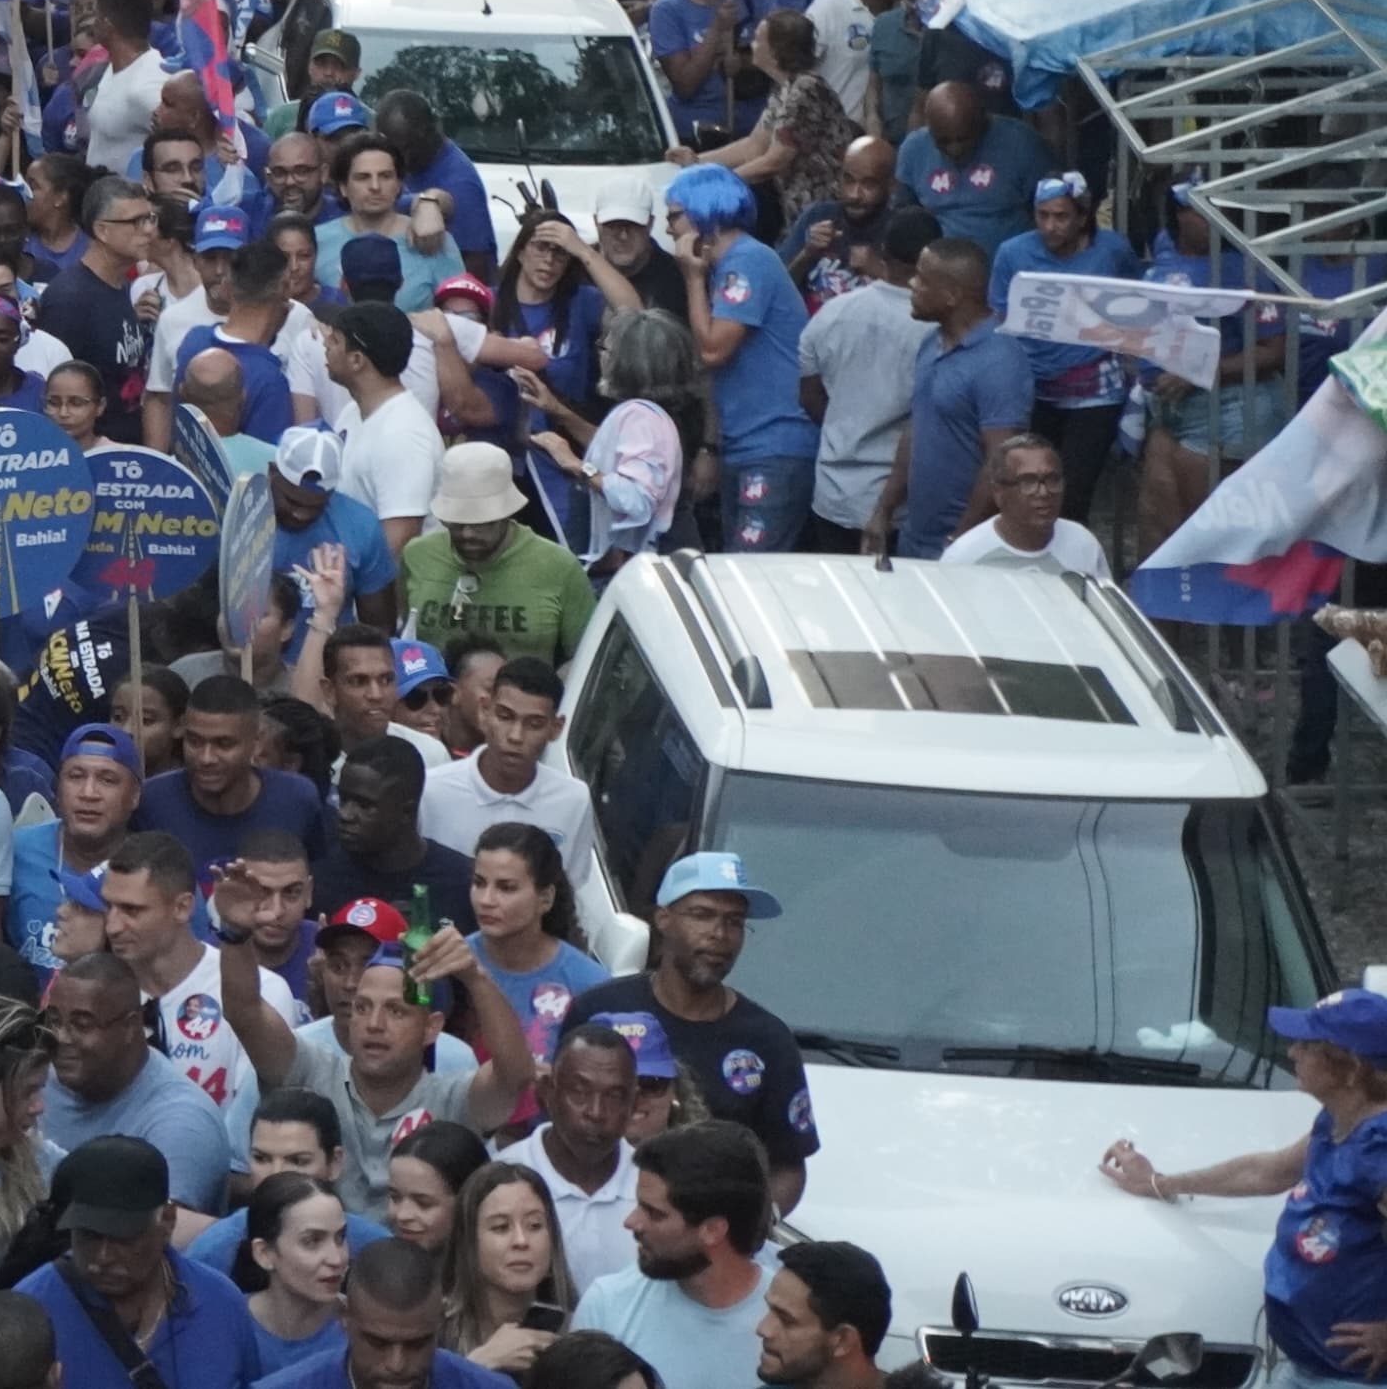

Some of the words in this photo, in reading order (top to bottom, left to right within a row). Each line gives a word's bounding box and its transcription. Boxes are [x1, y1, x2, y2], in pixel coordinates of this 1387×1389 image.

[932, 171, 952, 192] 44
[970, 166, 993, 188] 44
[109, 459, 143, 480] Tô
[95, 482, 195, 500] ESTRADA
[2, 488, 93, 523] Neto
[114, 498, 146, 510] COM
[134, 511, 220, 537] Neto
[15, 528, 68, 547] Bahia!
[86, 541, 115, 554] uda
[148, 543, 197, 557] Bahia!
[415, 599, 528, 634] COFFEE
[74, 620, 92, 643] NA
[95, 640, 113, 660] Tô
[78, 643, 107, 700] ESTRADA
[534, 989, 566, 1016] 44
[185, 1016, 214, 1038] 44
[1065, 1289, 1124, 1311] KIA
